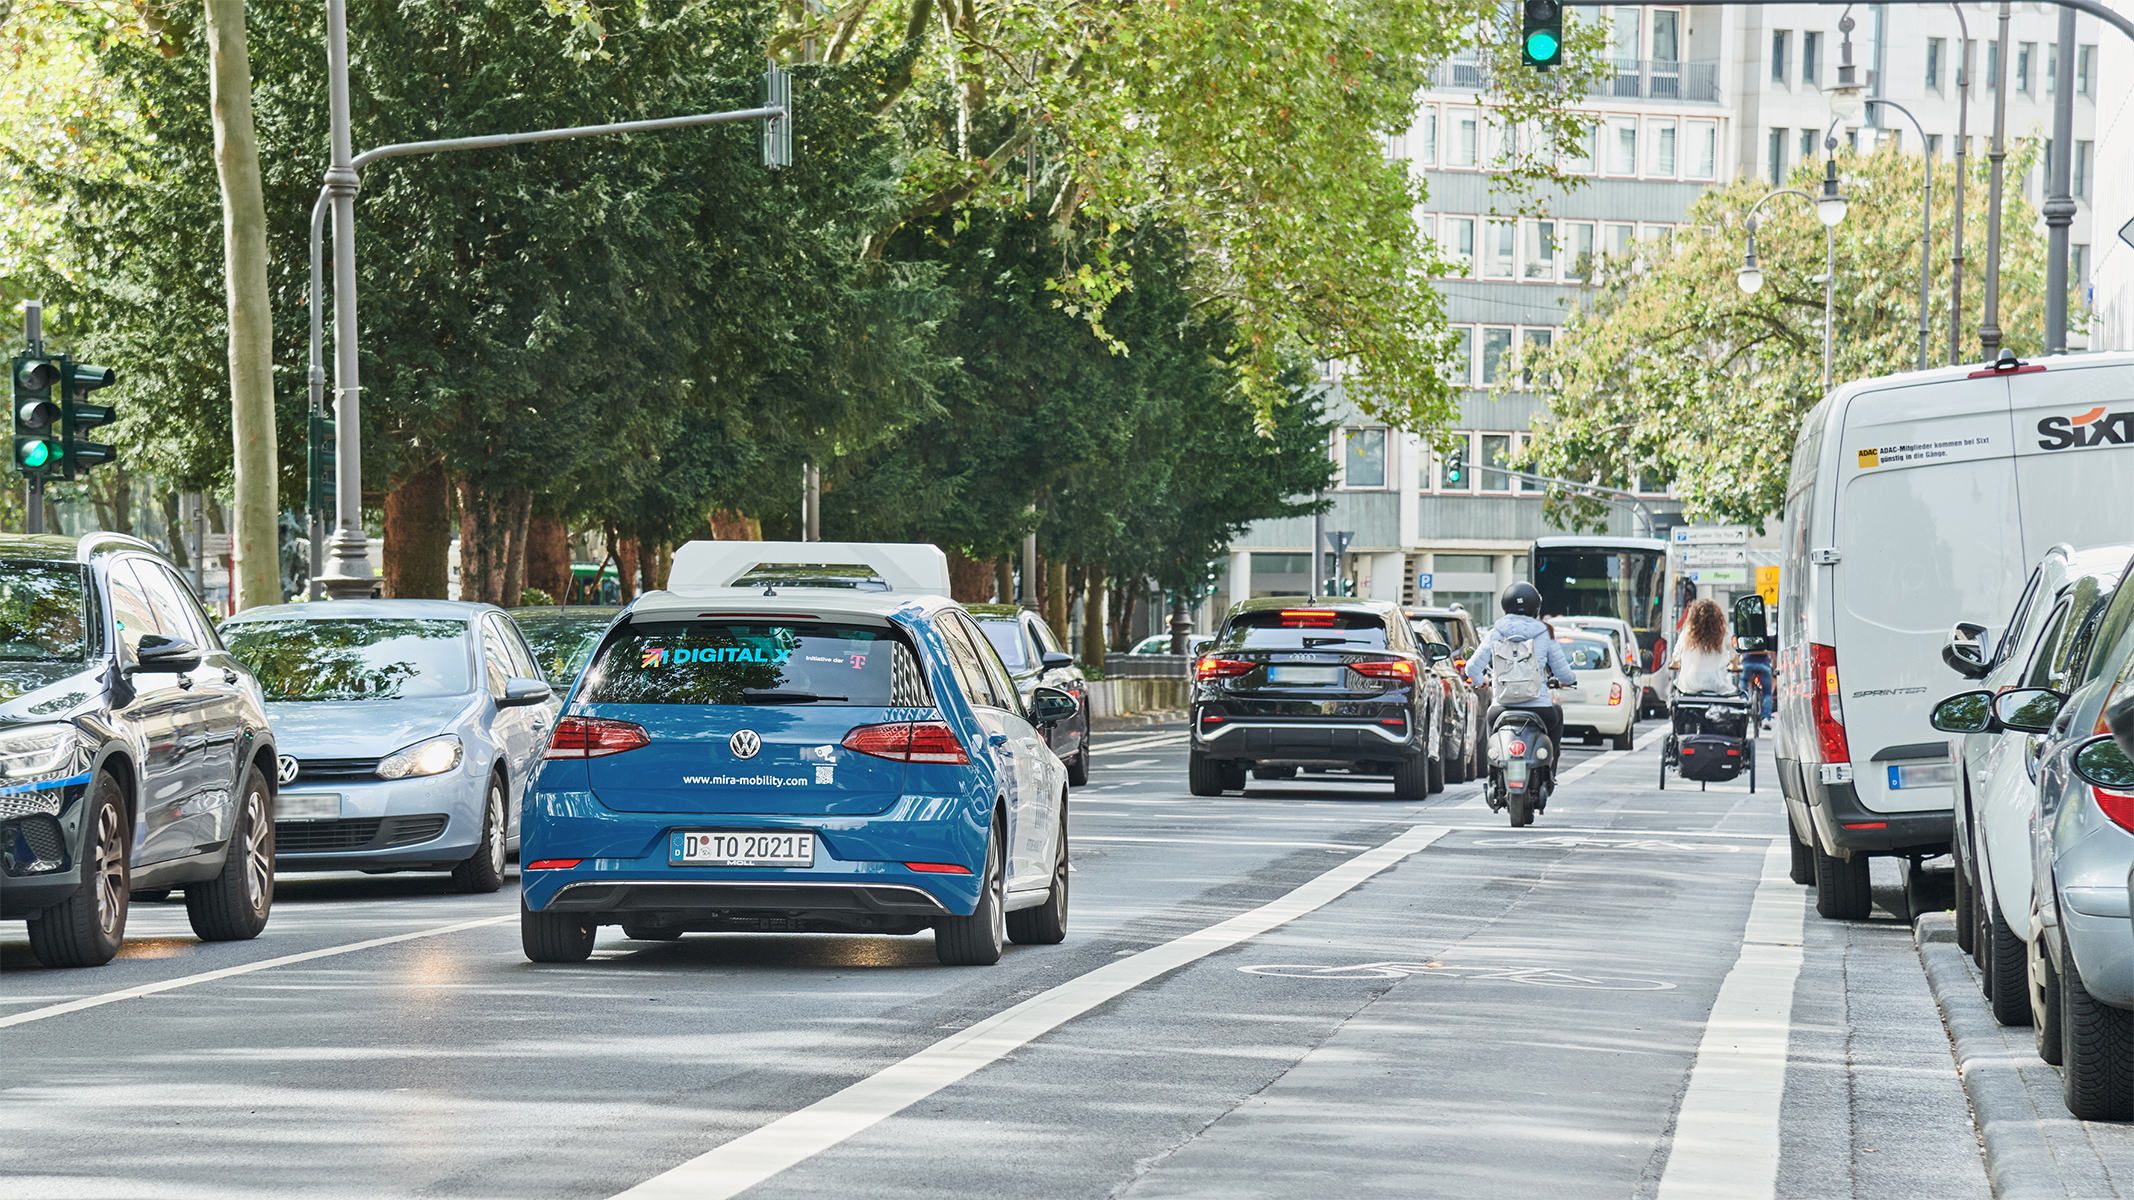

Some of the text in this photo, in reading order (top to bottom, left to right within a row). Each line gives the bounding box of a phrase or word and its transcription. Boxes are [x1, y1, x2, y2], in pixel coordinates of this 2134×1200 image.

[1880, 443, 1932, 454] ADAC-Mitglieder
[1934, 440, 1962, 448] kommen
[1880, 454, 1904, 463] günstig
[673, 648, 791, 663] DIGITAL X
[805, 655, 832, 663] Initiative
[1852, 686, 1927, 698] SPRINTER
[683, 774, 808, 787] www.mira-mobility.com
[686, 836, 698, 858] D
